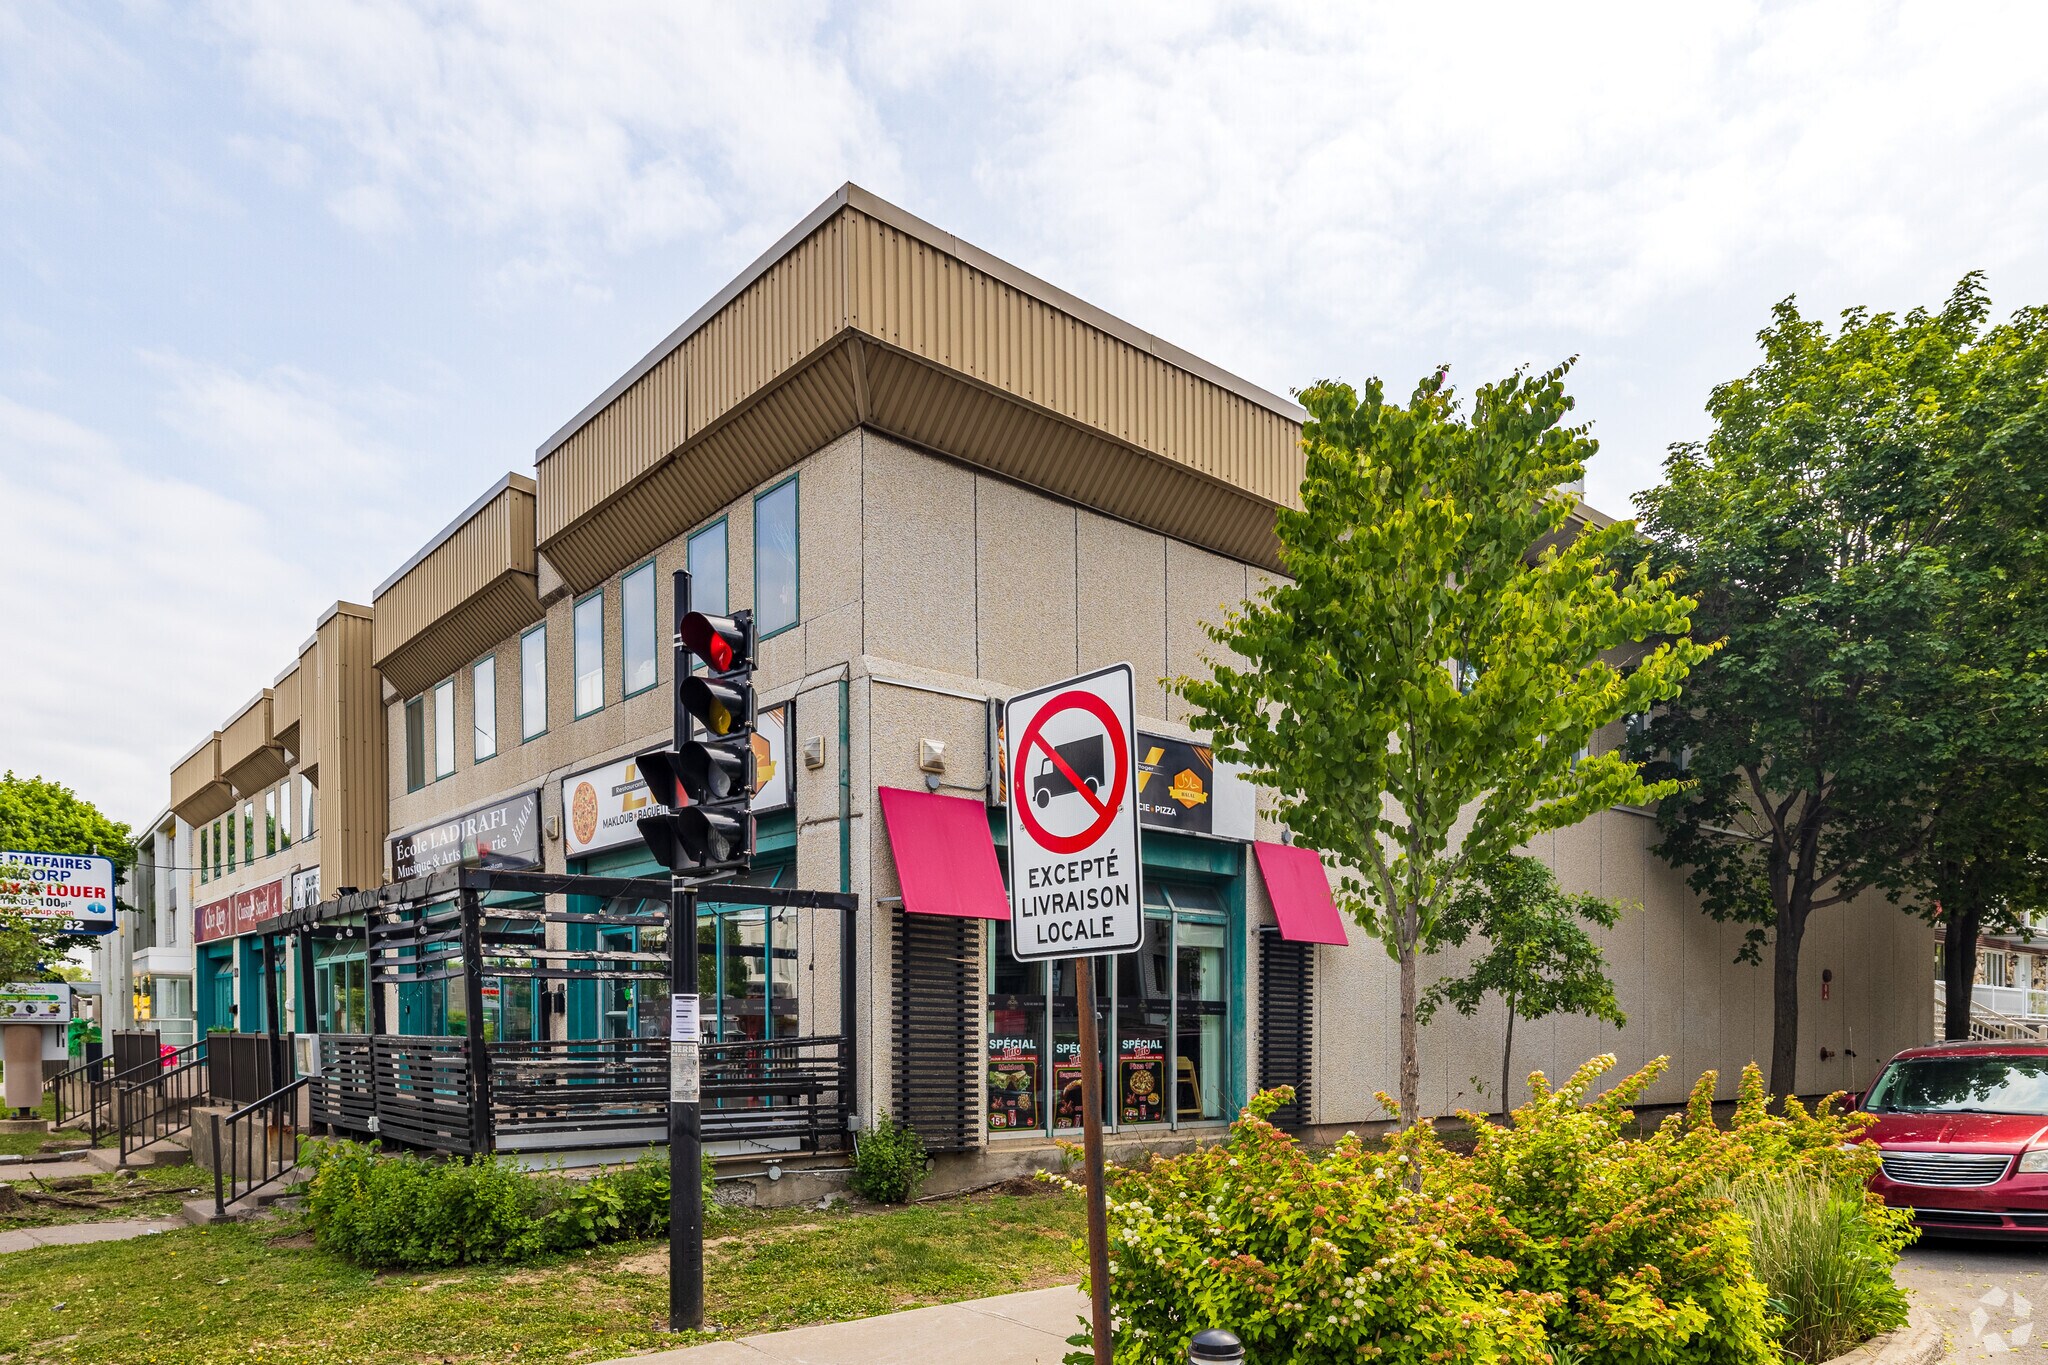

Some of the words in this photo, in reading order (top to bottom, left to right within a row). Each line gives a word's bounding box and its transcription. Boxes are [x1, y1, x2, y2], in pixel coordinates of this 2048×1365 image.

[1155, 805, 1177, 816] PIZZA
[603, 812, 634, 829] MAKLOUB
[396, 839, 428, 861] École
[415, 807, 508, 849] LADJRAFI
[9, 854, 92, 870] D'AFFAIRES
[397, 860, 434, 880] Musique
[432, 853, 441, 868] &
[441, 848, 461, 865] Arts
[1029, 848, 1119, 889] EXCEPTÉ
[46, 884, 106, 899] LOUER
[1022, 884, 1129, 918] LIVRAISON
[1037, 916, 1115, 945] LOCALE
[989, 1037, 1036, 1049] SPÉCIAL
[1122, 1038, 1163, 1049] SPÉCIAL
[1002, 1047, 1021, 1058] Trio
[1134, 1046, 1150, 1058] Trio
